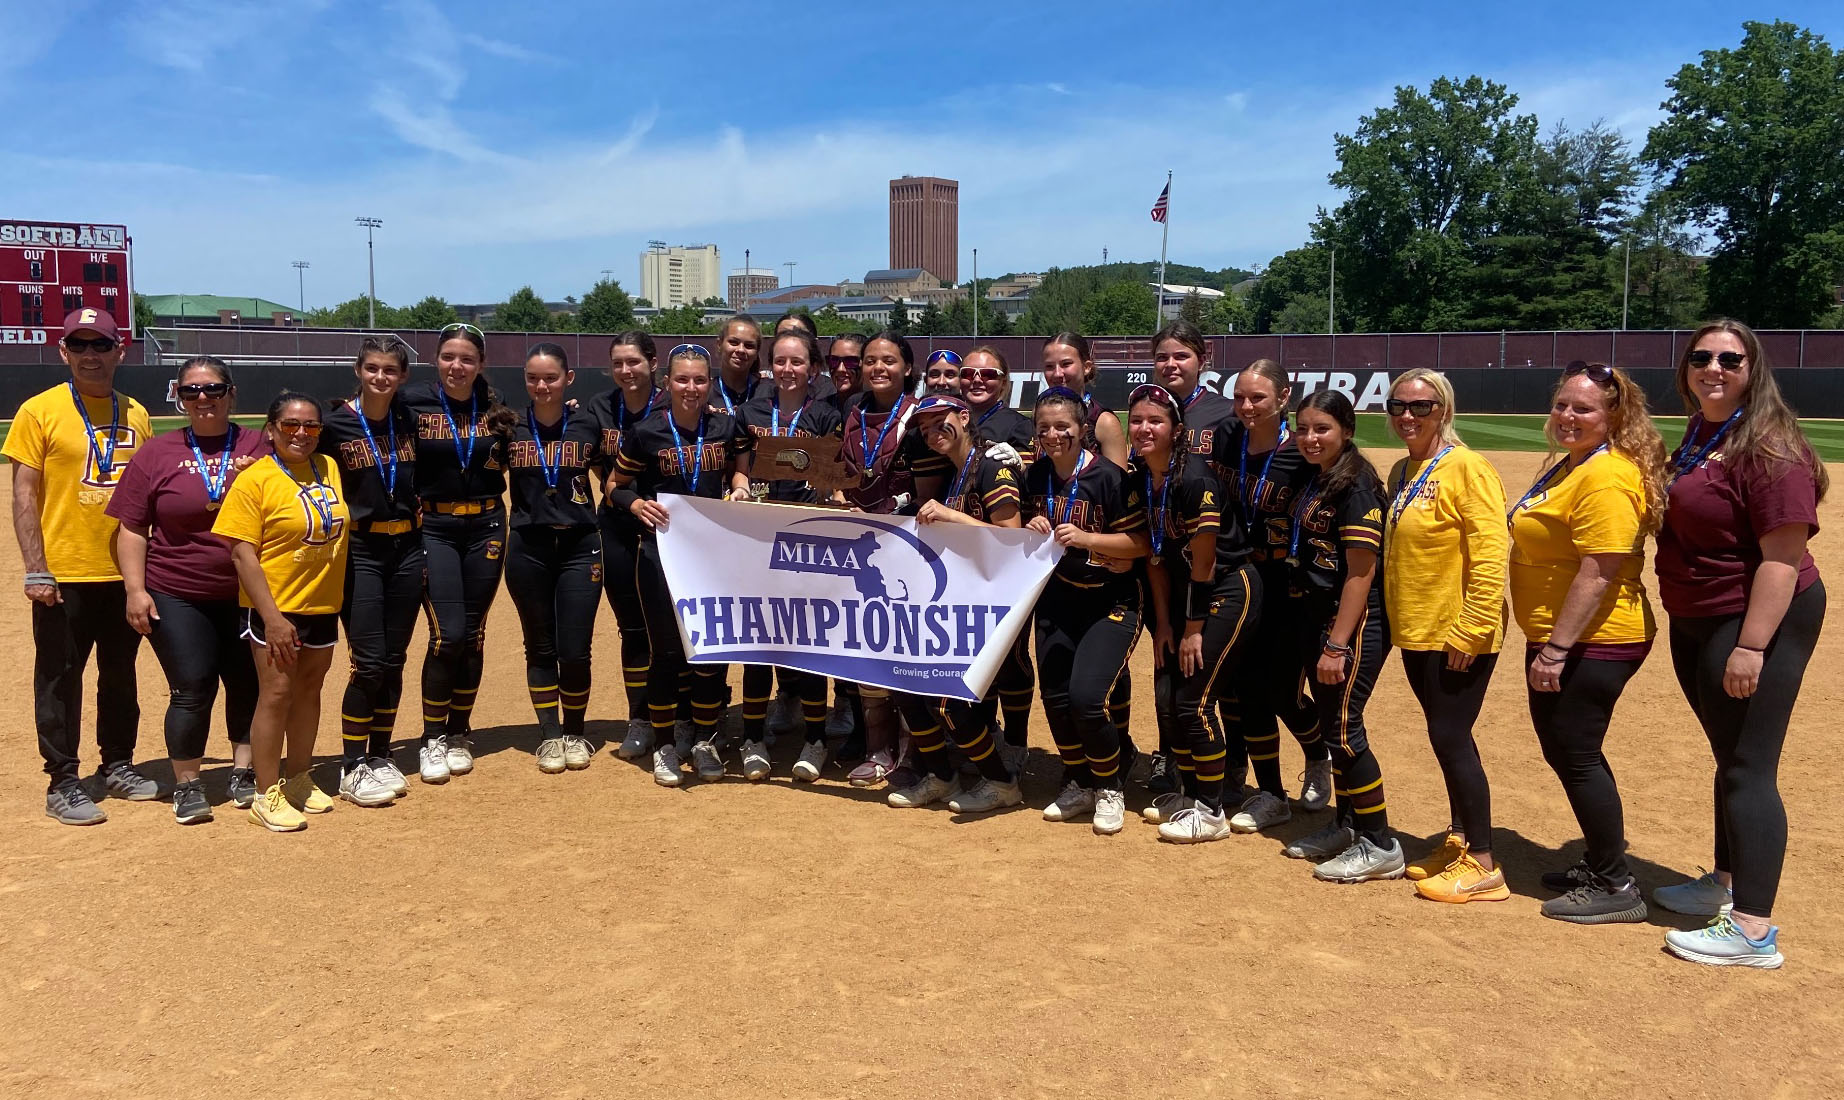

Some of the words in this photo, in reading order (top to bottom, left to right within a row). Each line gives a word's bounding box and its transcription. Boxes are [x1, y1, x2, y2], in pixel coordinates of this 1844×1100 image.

[0, 225, 122, 247] SOFTBALL
[24, 250, 45, 260] OUT
[90, 253, 108, 263] H/E
[18, 285, 44, 294] RUNS
[62, 286, 83, 295] HITS
[100, 287, 118, 296] ERR
[1126, 372, 1147, 384] 220
[778, 540, 861, 571] MIAA
[893, 666, 930, 679] Growing
